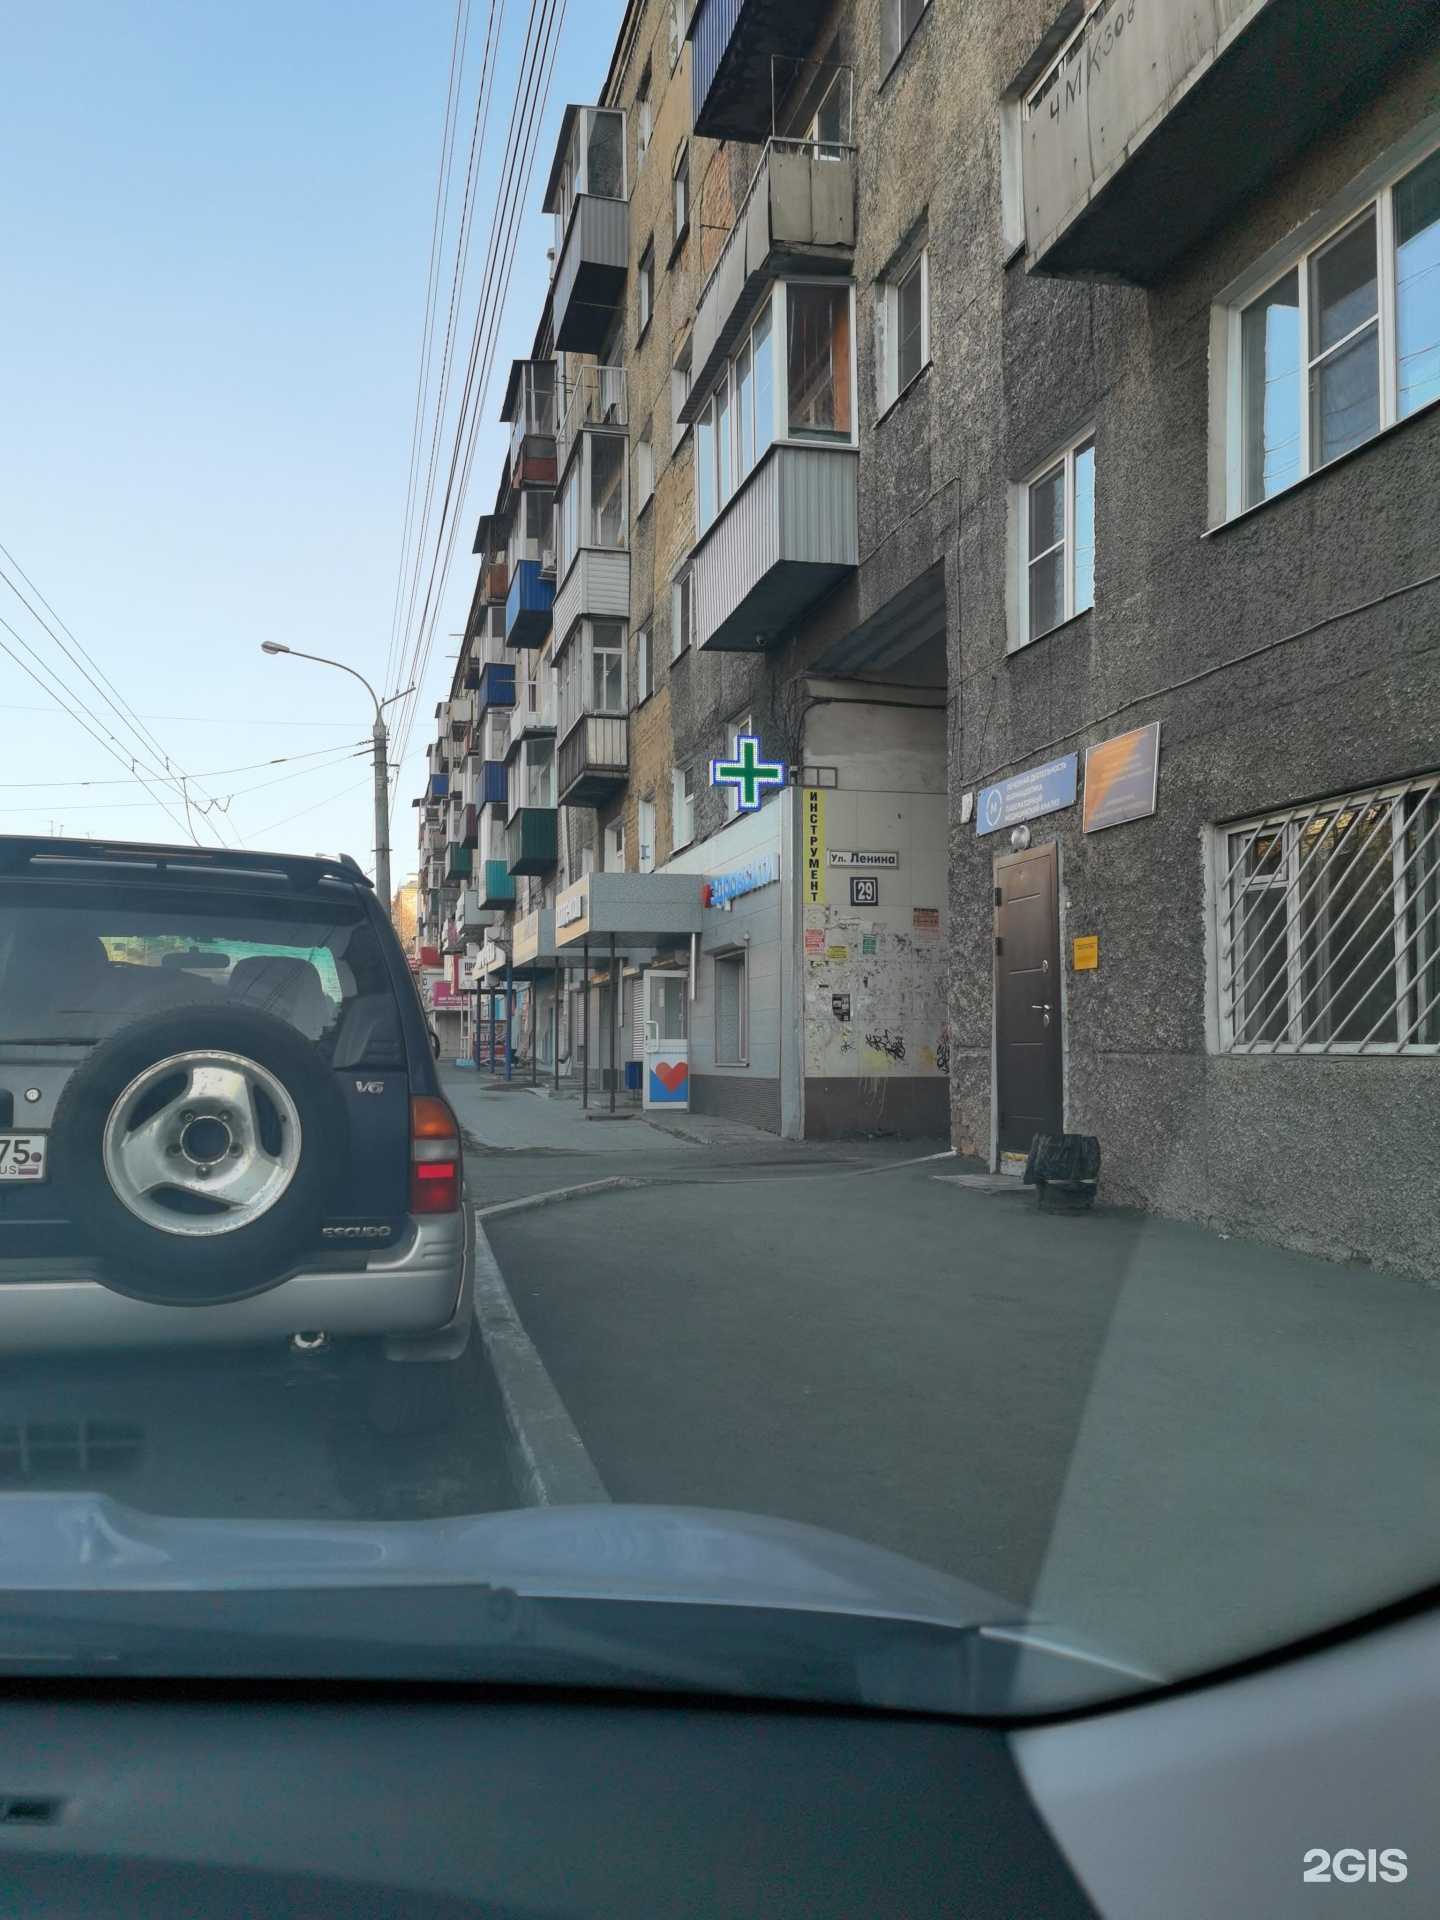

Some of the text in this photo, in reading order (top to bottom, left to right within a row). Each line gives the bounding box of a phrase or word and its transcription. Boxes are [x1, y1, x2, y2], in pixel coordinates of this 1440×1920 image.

[809, 791, 819, 902] ИНСТРУМЕНТ
[850, 852, 896, 864] Ленина
[858, 882, 873, 900] 29
[0, 1139, 30, 1165] 75
